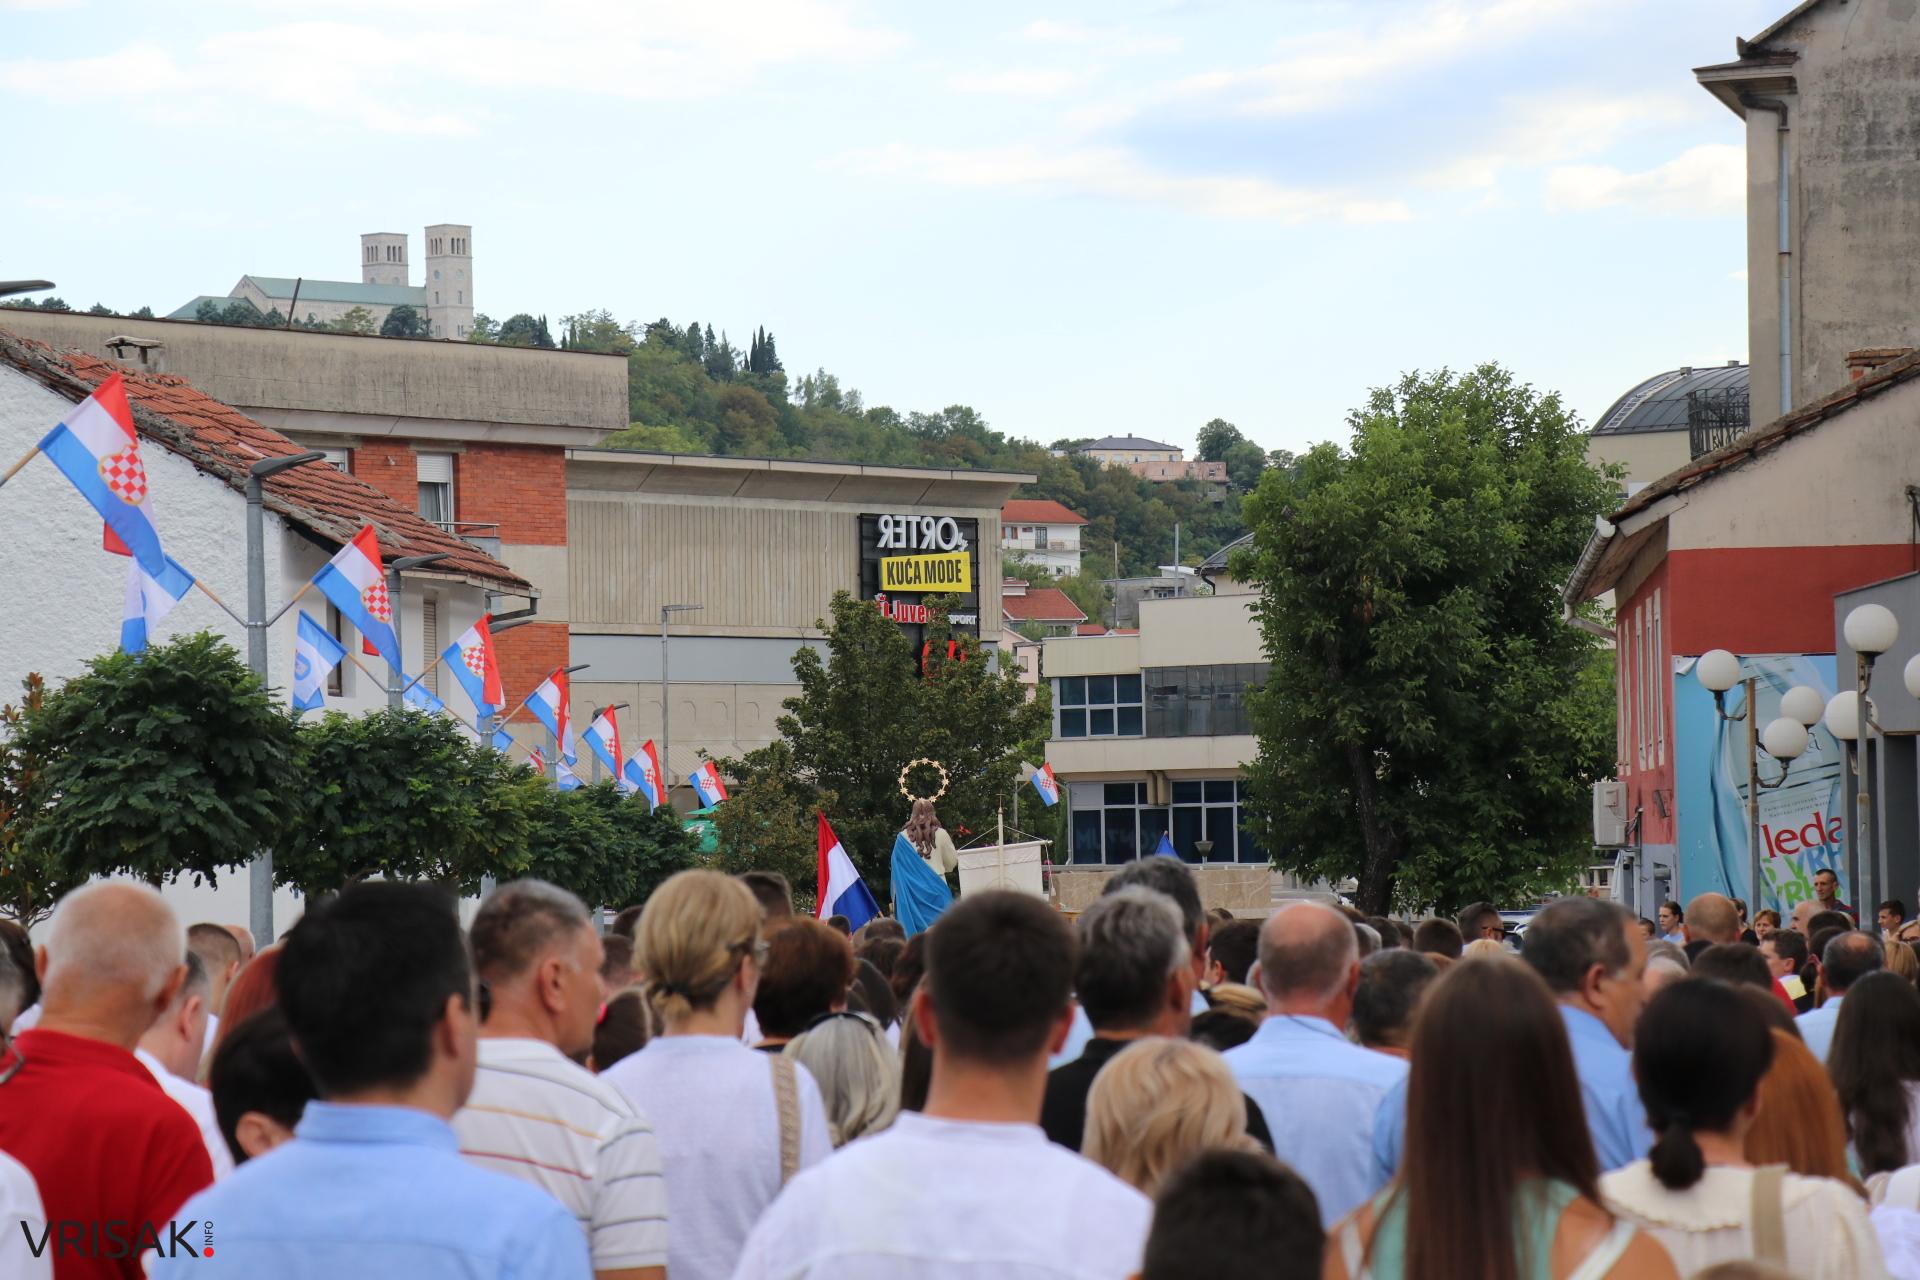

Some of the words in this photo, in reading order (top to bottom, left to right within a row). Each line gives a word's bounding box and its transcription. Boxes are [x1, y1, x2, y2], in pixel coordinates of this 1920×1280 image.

[886, 558, 921, 586] KUĆA
[924, 559, 962, 584] MODE
[948, 614, 977, 625] SPORT
